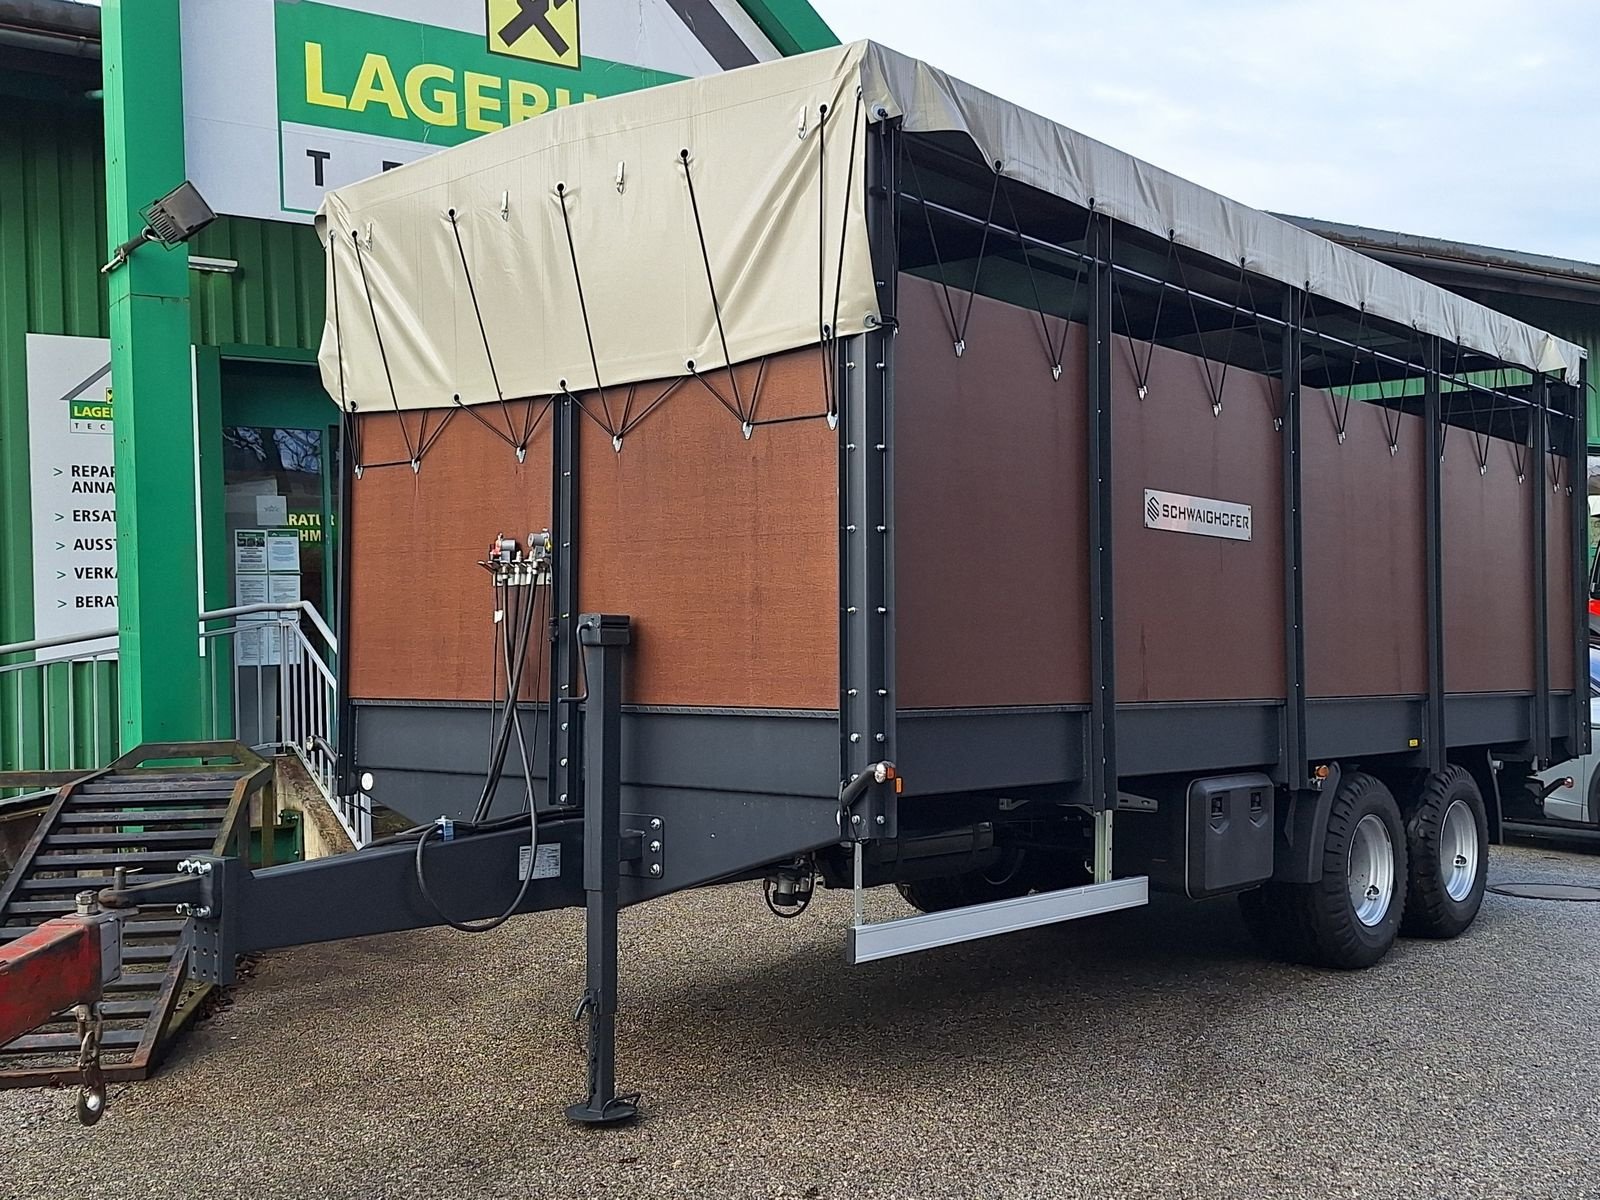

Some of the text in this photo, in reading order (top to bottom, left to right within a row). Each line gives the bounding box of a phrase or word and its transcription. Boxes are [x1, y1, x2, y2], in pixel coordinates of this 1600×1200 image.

[73, 405, 113, 418] LAGE
[71, 481, 116, 494] ANNA
[1162, 503, 1249, 529] SCHWAIGHOFER
[74, 567, 118, 580] VERK
